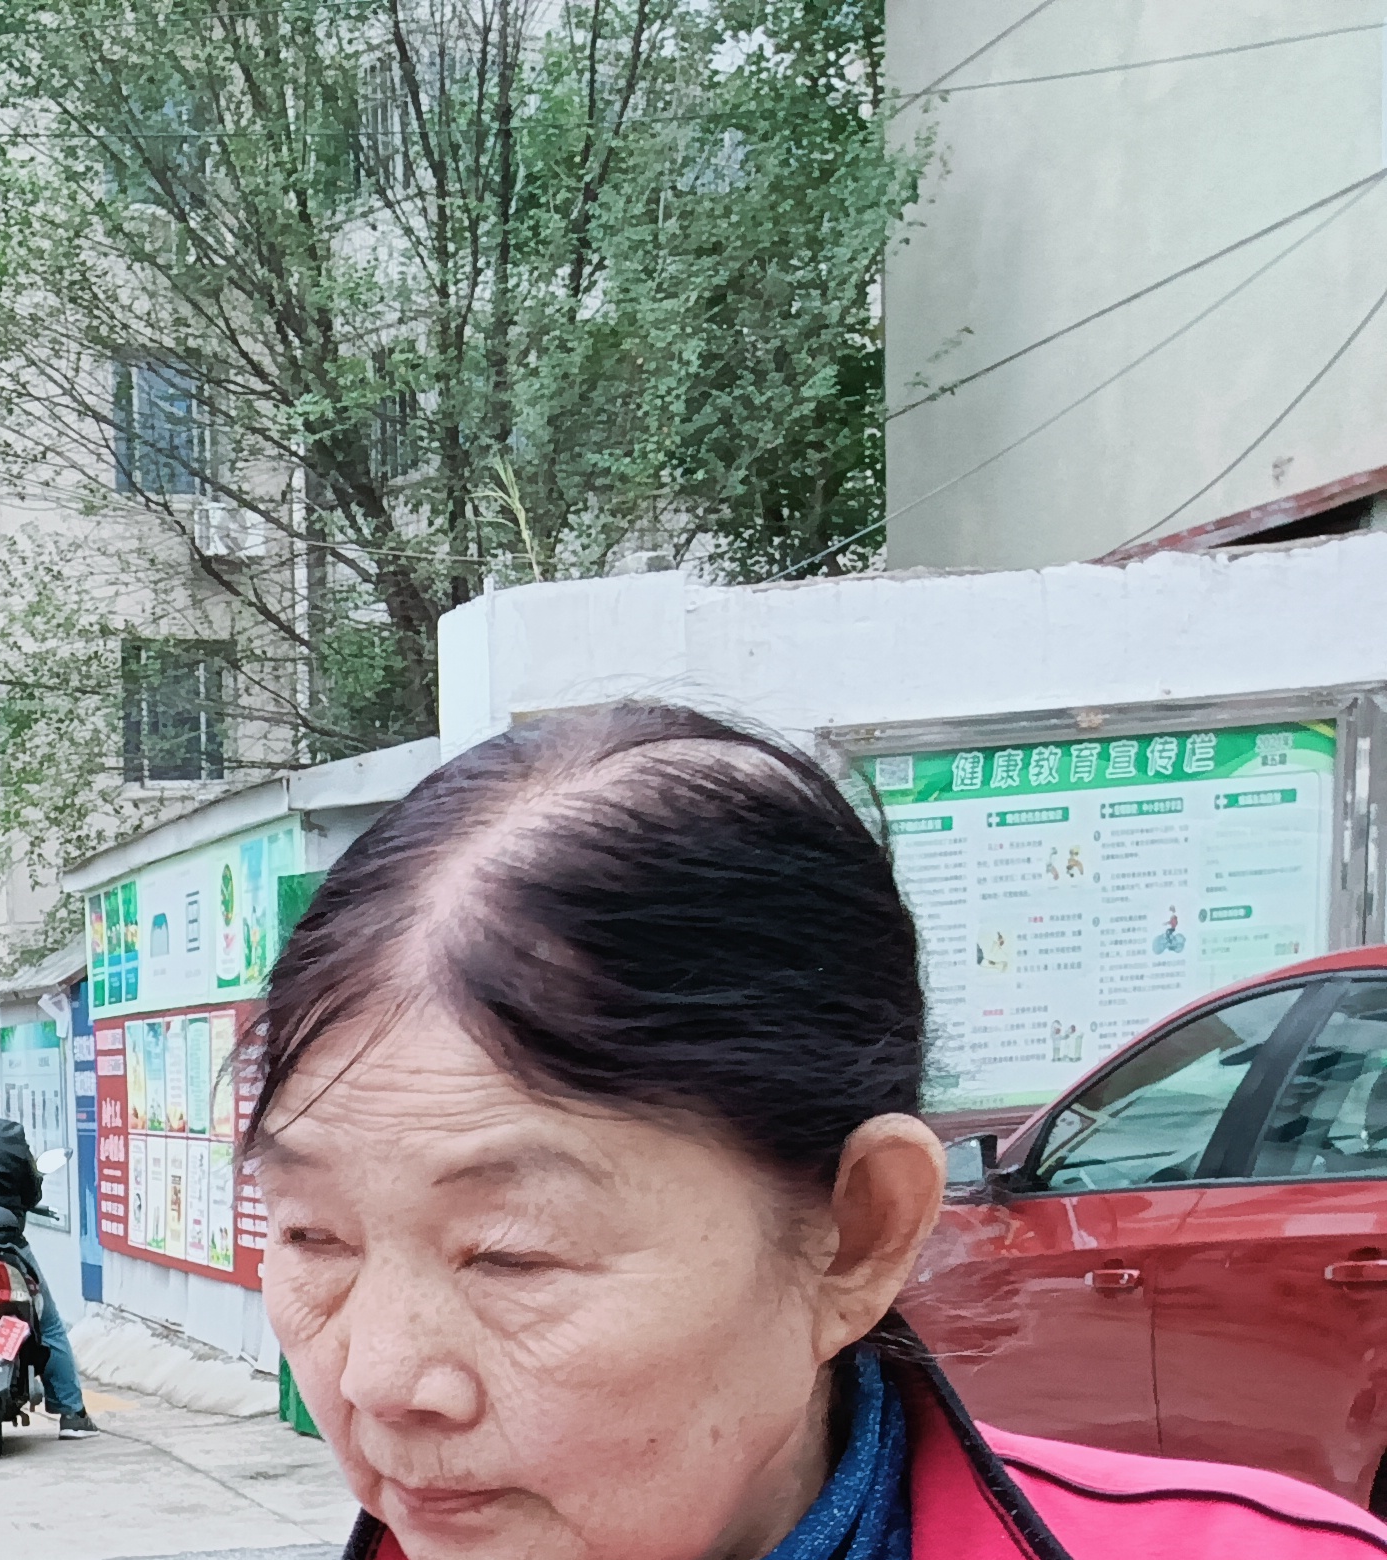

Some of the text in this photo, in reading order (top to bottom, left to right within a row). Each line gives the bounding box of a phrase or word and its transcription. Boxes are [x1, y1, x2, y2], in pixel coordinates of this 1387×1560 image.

[952, 733, 1217, 791] 健康教育宣传栏
